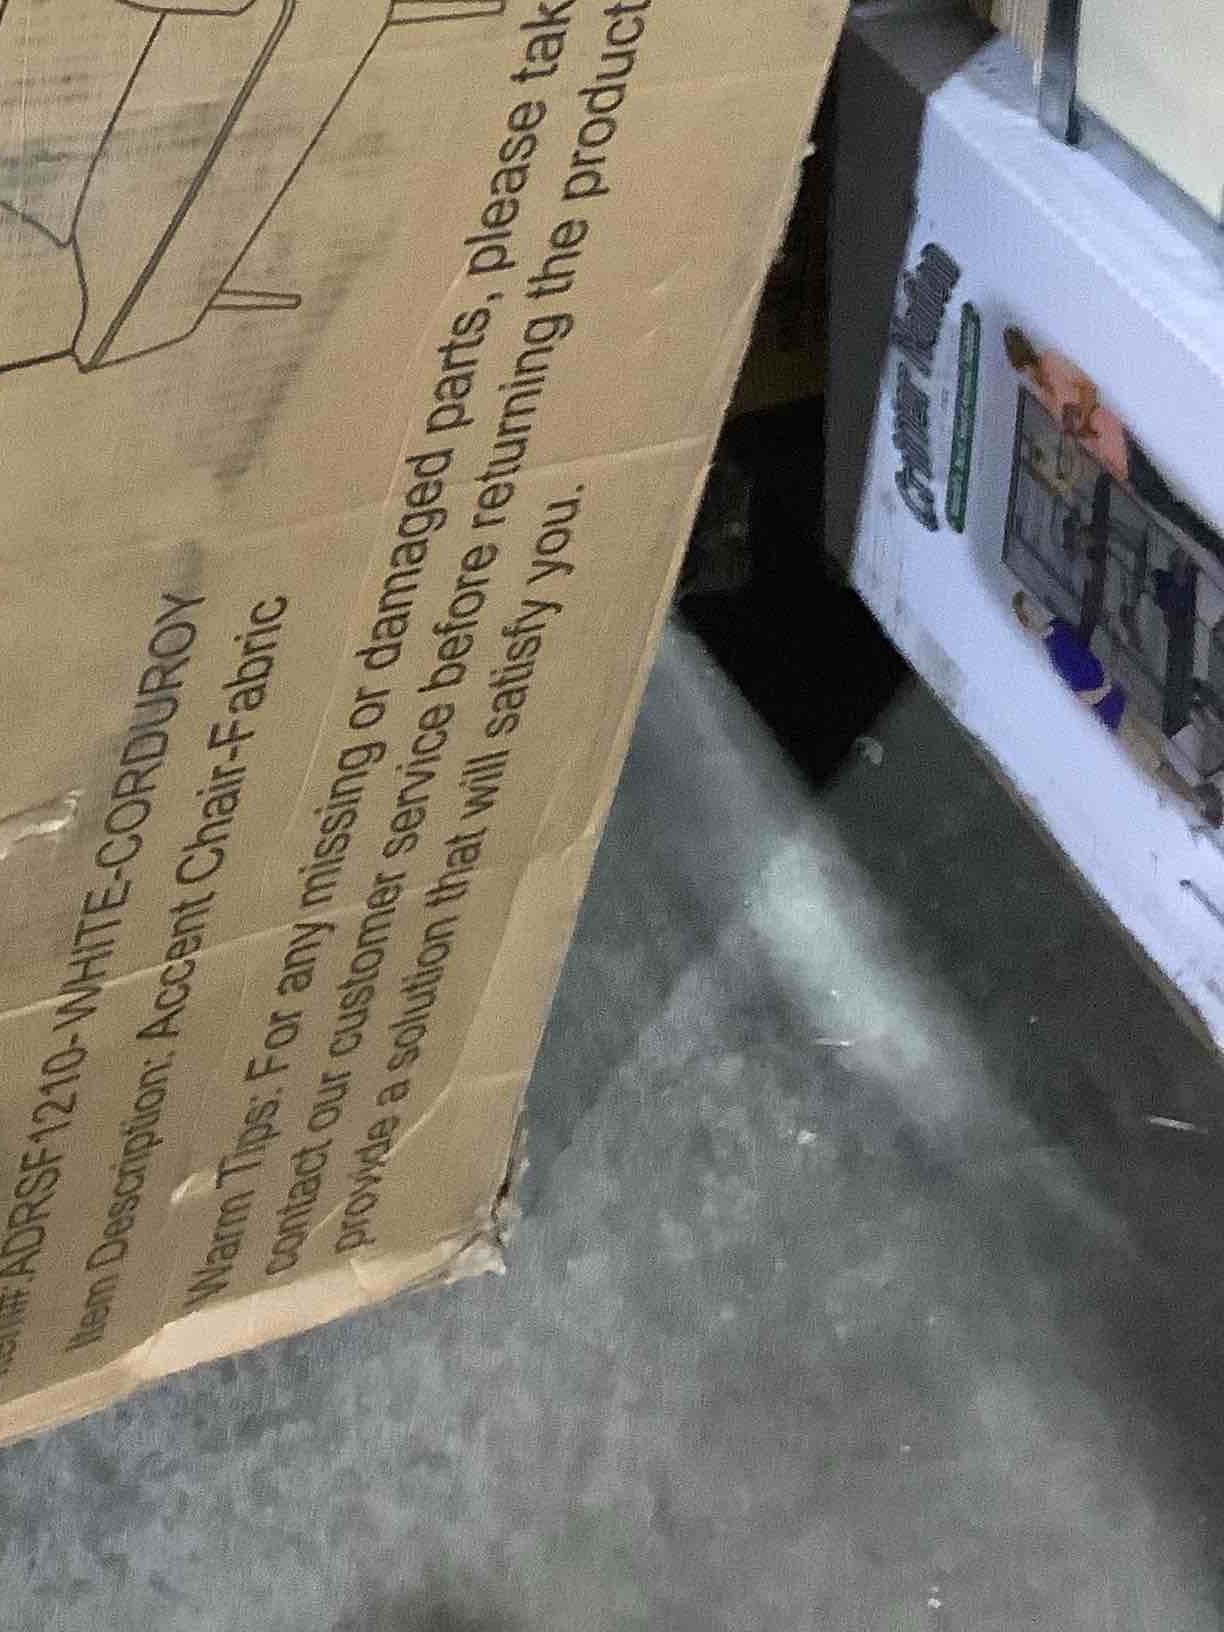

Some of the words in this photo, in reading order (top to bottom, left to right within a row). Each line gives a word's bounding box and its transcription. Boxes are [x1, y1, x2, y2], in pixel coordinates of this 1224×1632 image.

[463, 100, 547, 276] please
[526, 219, 590, 299] the
[426, 291, 504, 435] parts,
[471, 312, 575, 529] returning
[355, 447, 455, 670] damaged
[526, 483, 585, 585] you.
[417, 542, 499, 694] before
[485, 599, 563, 739] satisfy
[348, 686, 392, 730] or
[298, 741, 387, 909] missing
[382, 702, 456, 859] service
[458, 748, 511, 820] will
[425, 825, 489, 909] that
[136, 890, 216, 1040] Accent
[276, 921, 338, 996] any
[329, 871, 407, 1057] customer
[387, 916, 459, 1072] solution
[243, 1009, 303, 1082] For
[307, 1069, 352, 1134] our
[377, 1078, 411, 1107] a
[86, 1050, 174, 1271] Description:
[266, 1139, 333, 1276] contact
[334, 1114, 400, 1255] provide
[65, 1273, 120, 1353] Item
[183, 1190, 256, 1308] Warm
